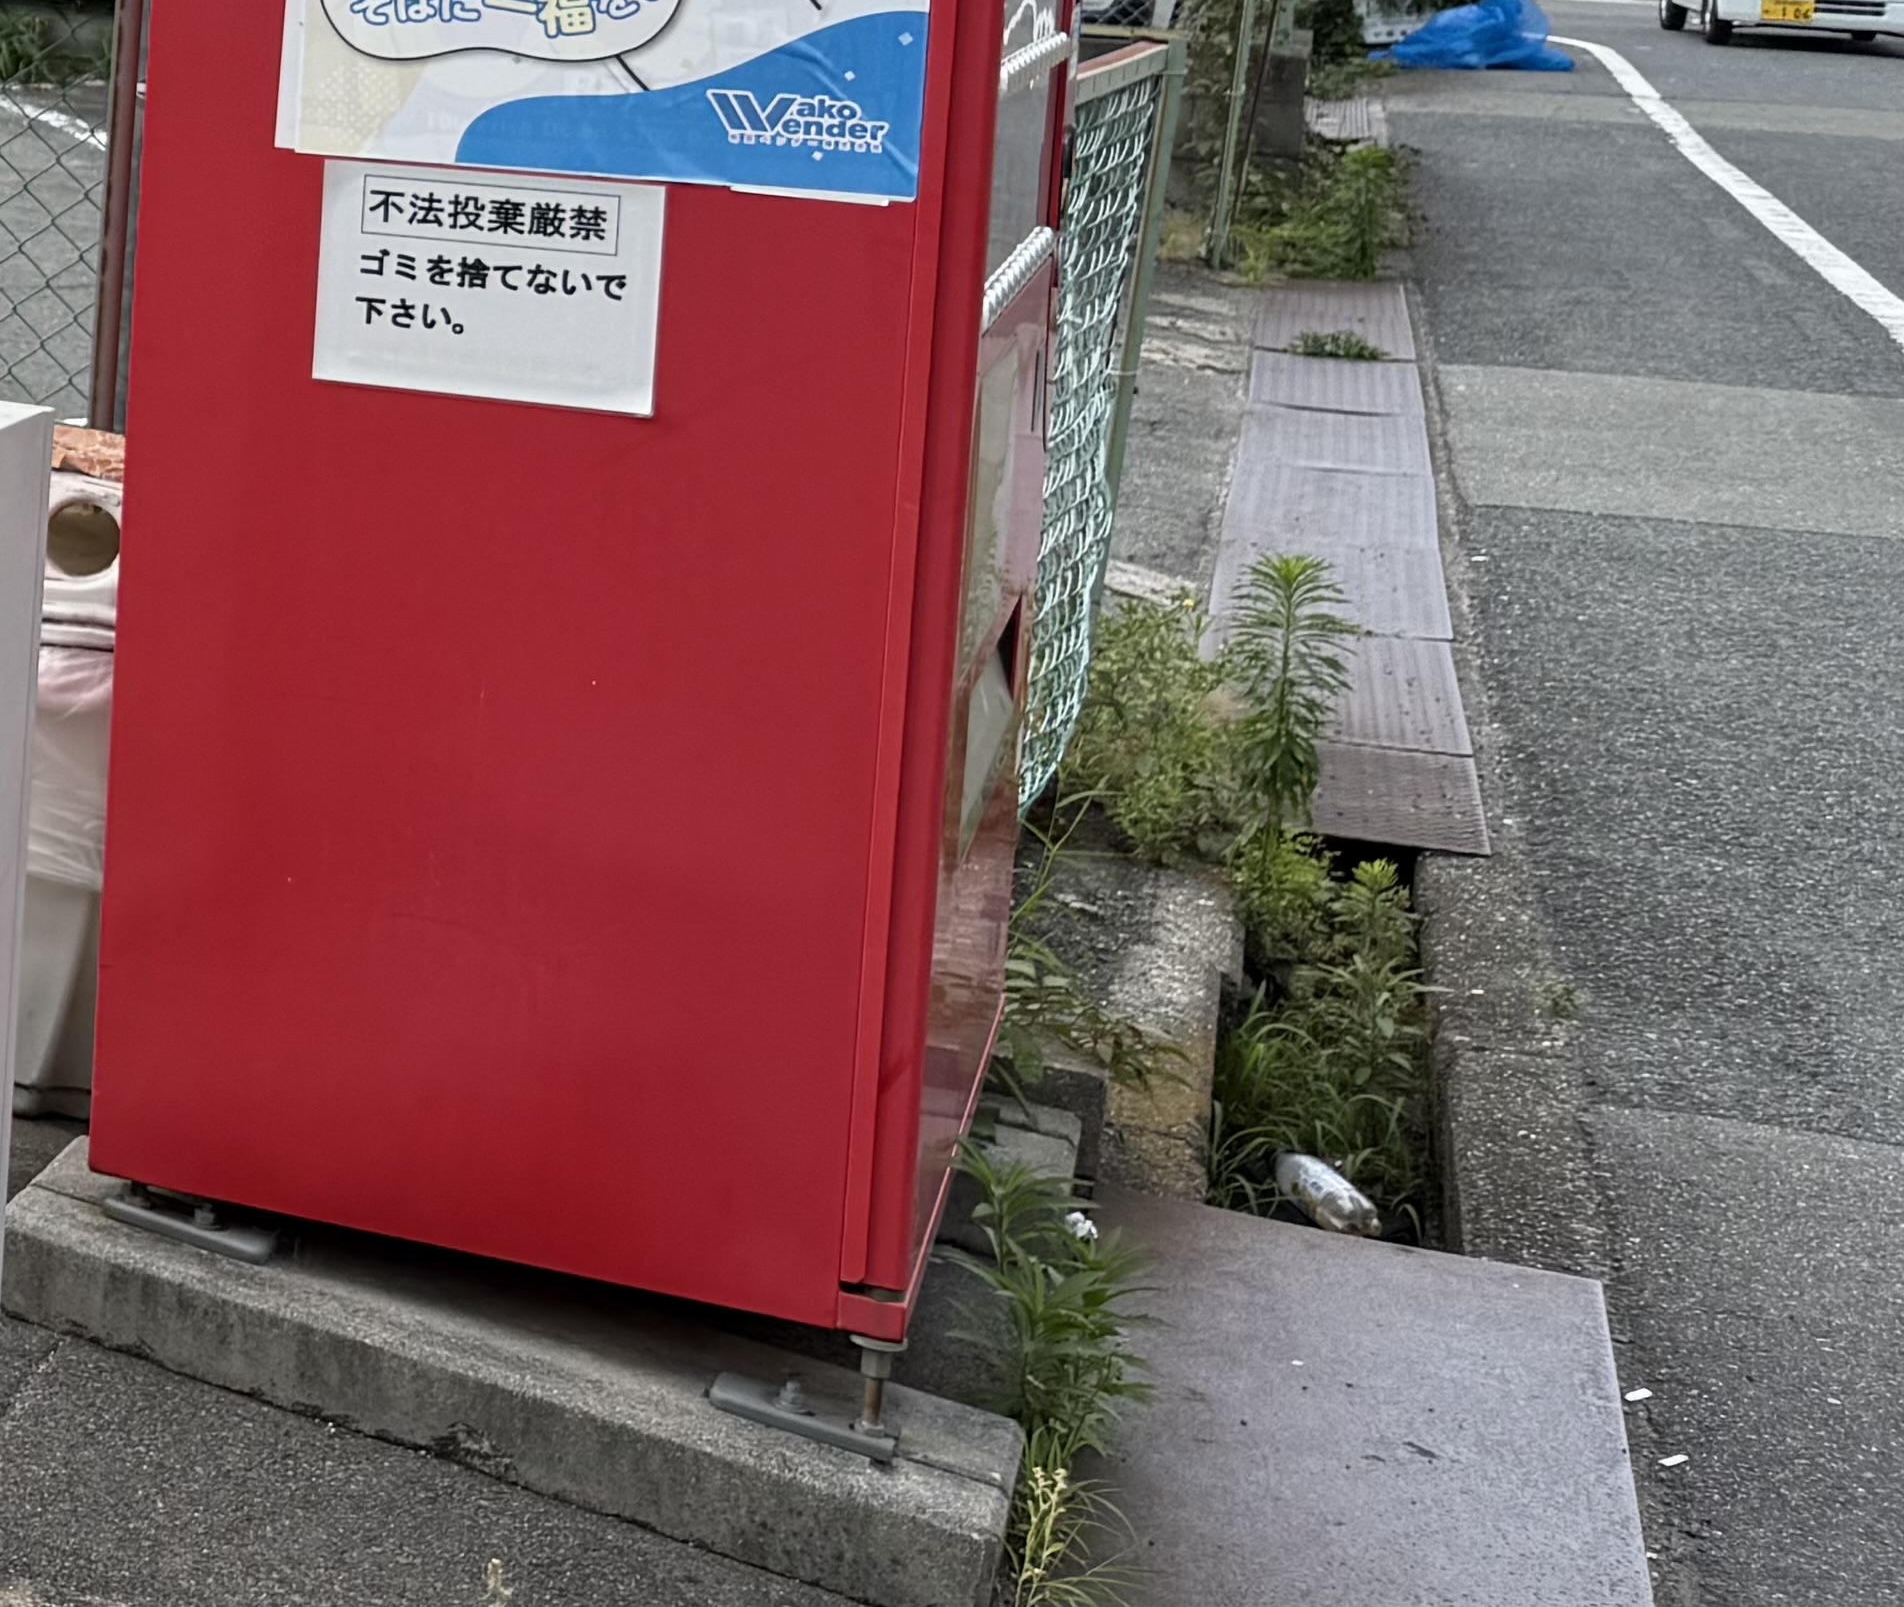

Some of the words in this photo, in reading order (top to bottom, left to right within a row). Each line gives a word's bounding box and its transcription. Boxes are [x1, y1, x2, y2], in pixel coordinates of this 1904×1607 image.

[368, 186, 608, 242] 不法投棄厳禁
[359, 249, 628, 302] ゴミを捨てないで
[356, 297, 466, 337] 下さい。
